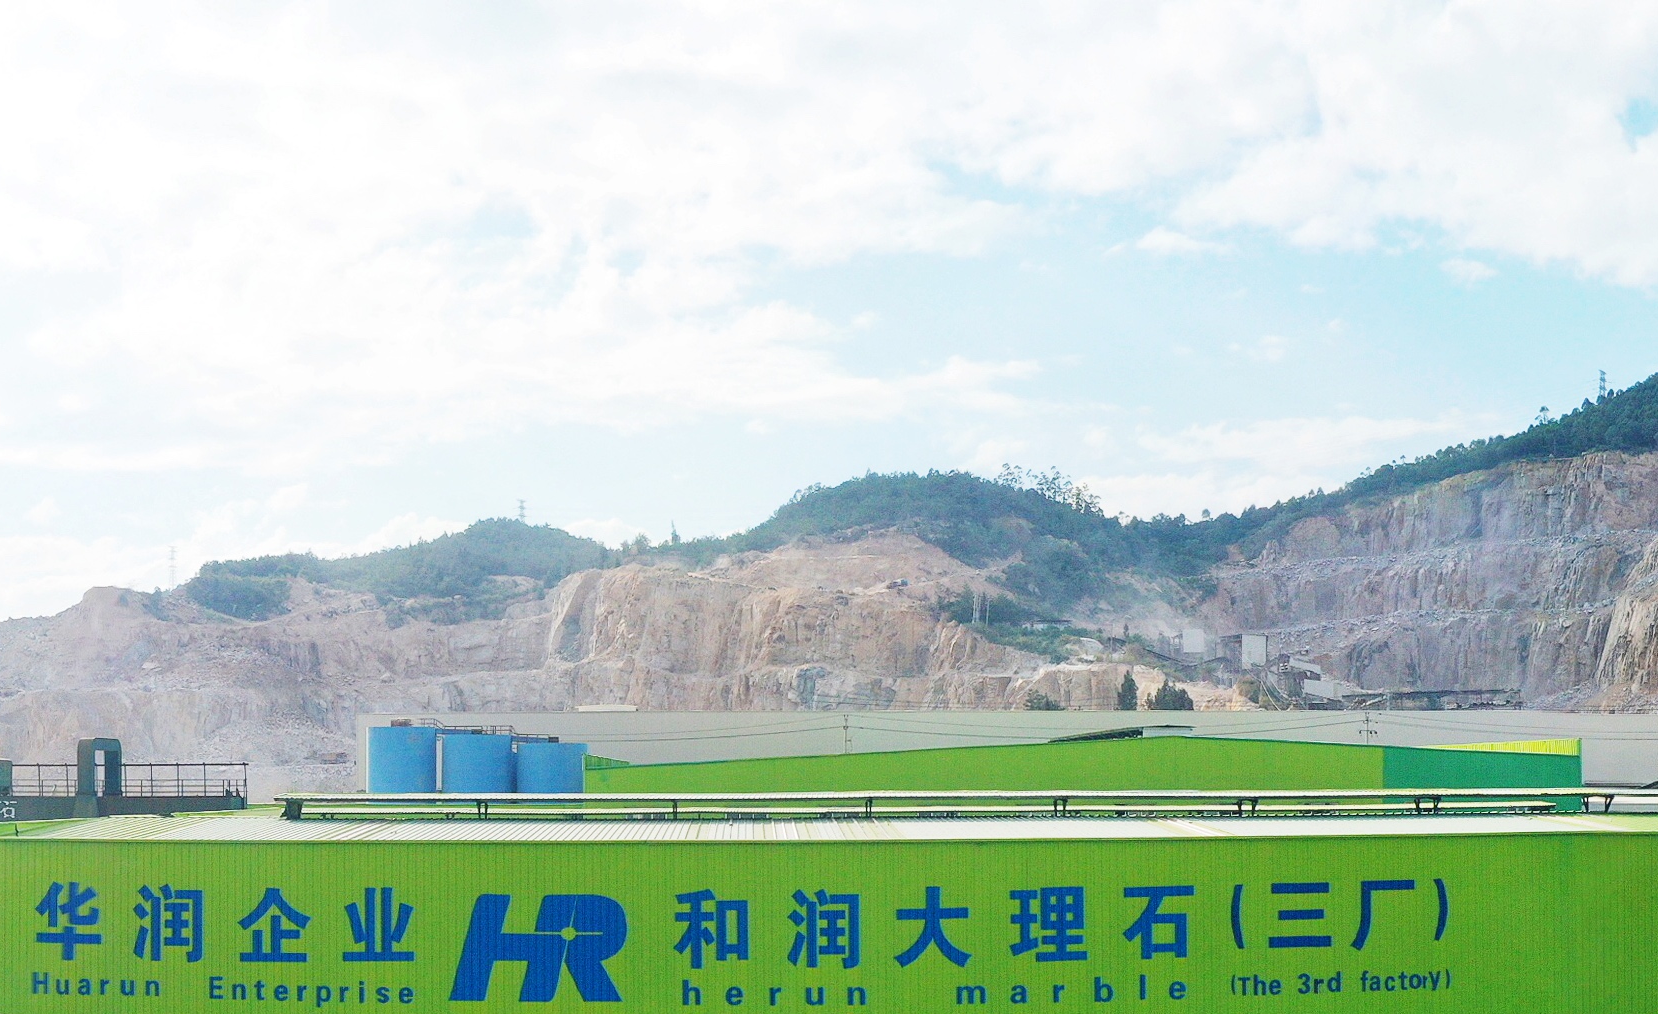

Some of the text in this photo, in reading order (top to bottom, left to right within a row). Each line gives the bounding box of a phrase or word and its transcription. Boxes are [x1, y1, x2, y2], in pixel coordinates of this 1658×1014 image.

[35, 881, 415, 965] 华润企业
[448, 893, 628, 1003] HR
[31, 967, 1453, 1007] Huarun Enterprise herun marble (The 3rd factory)
